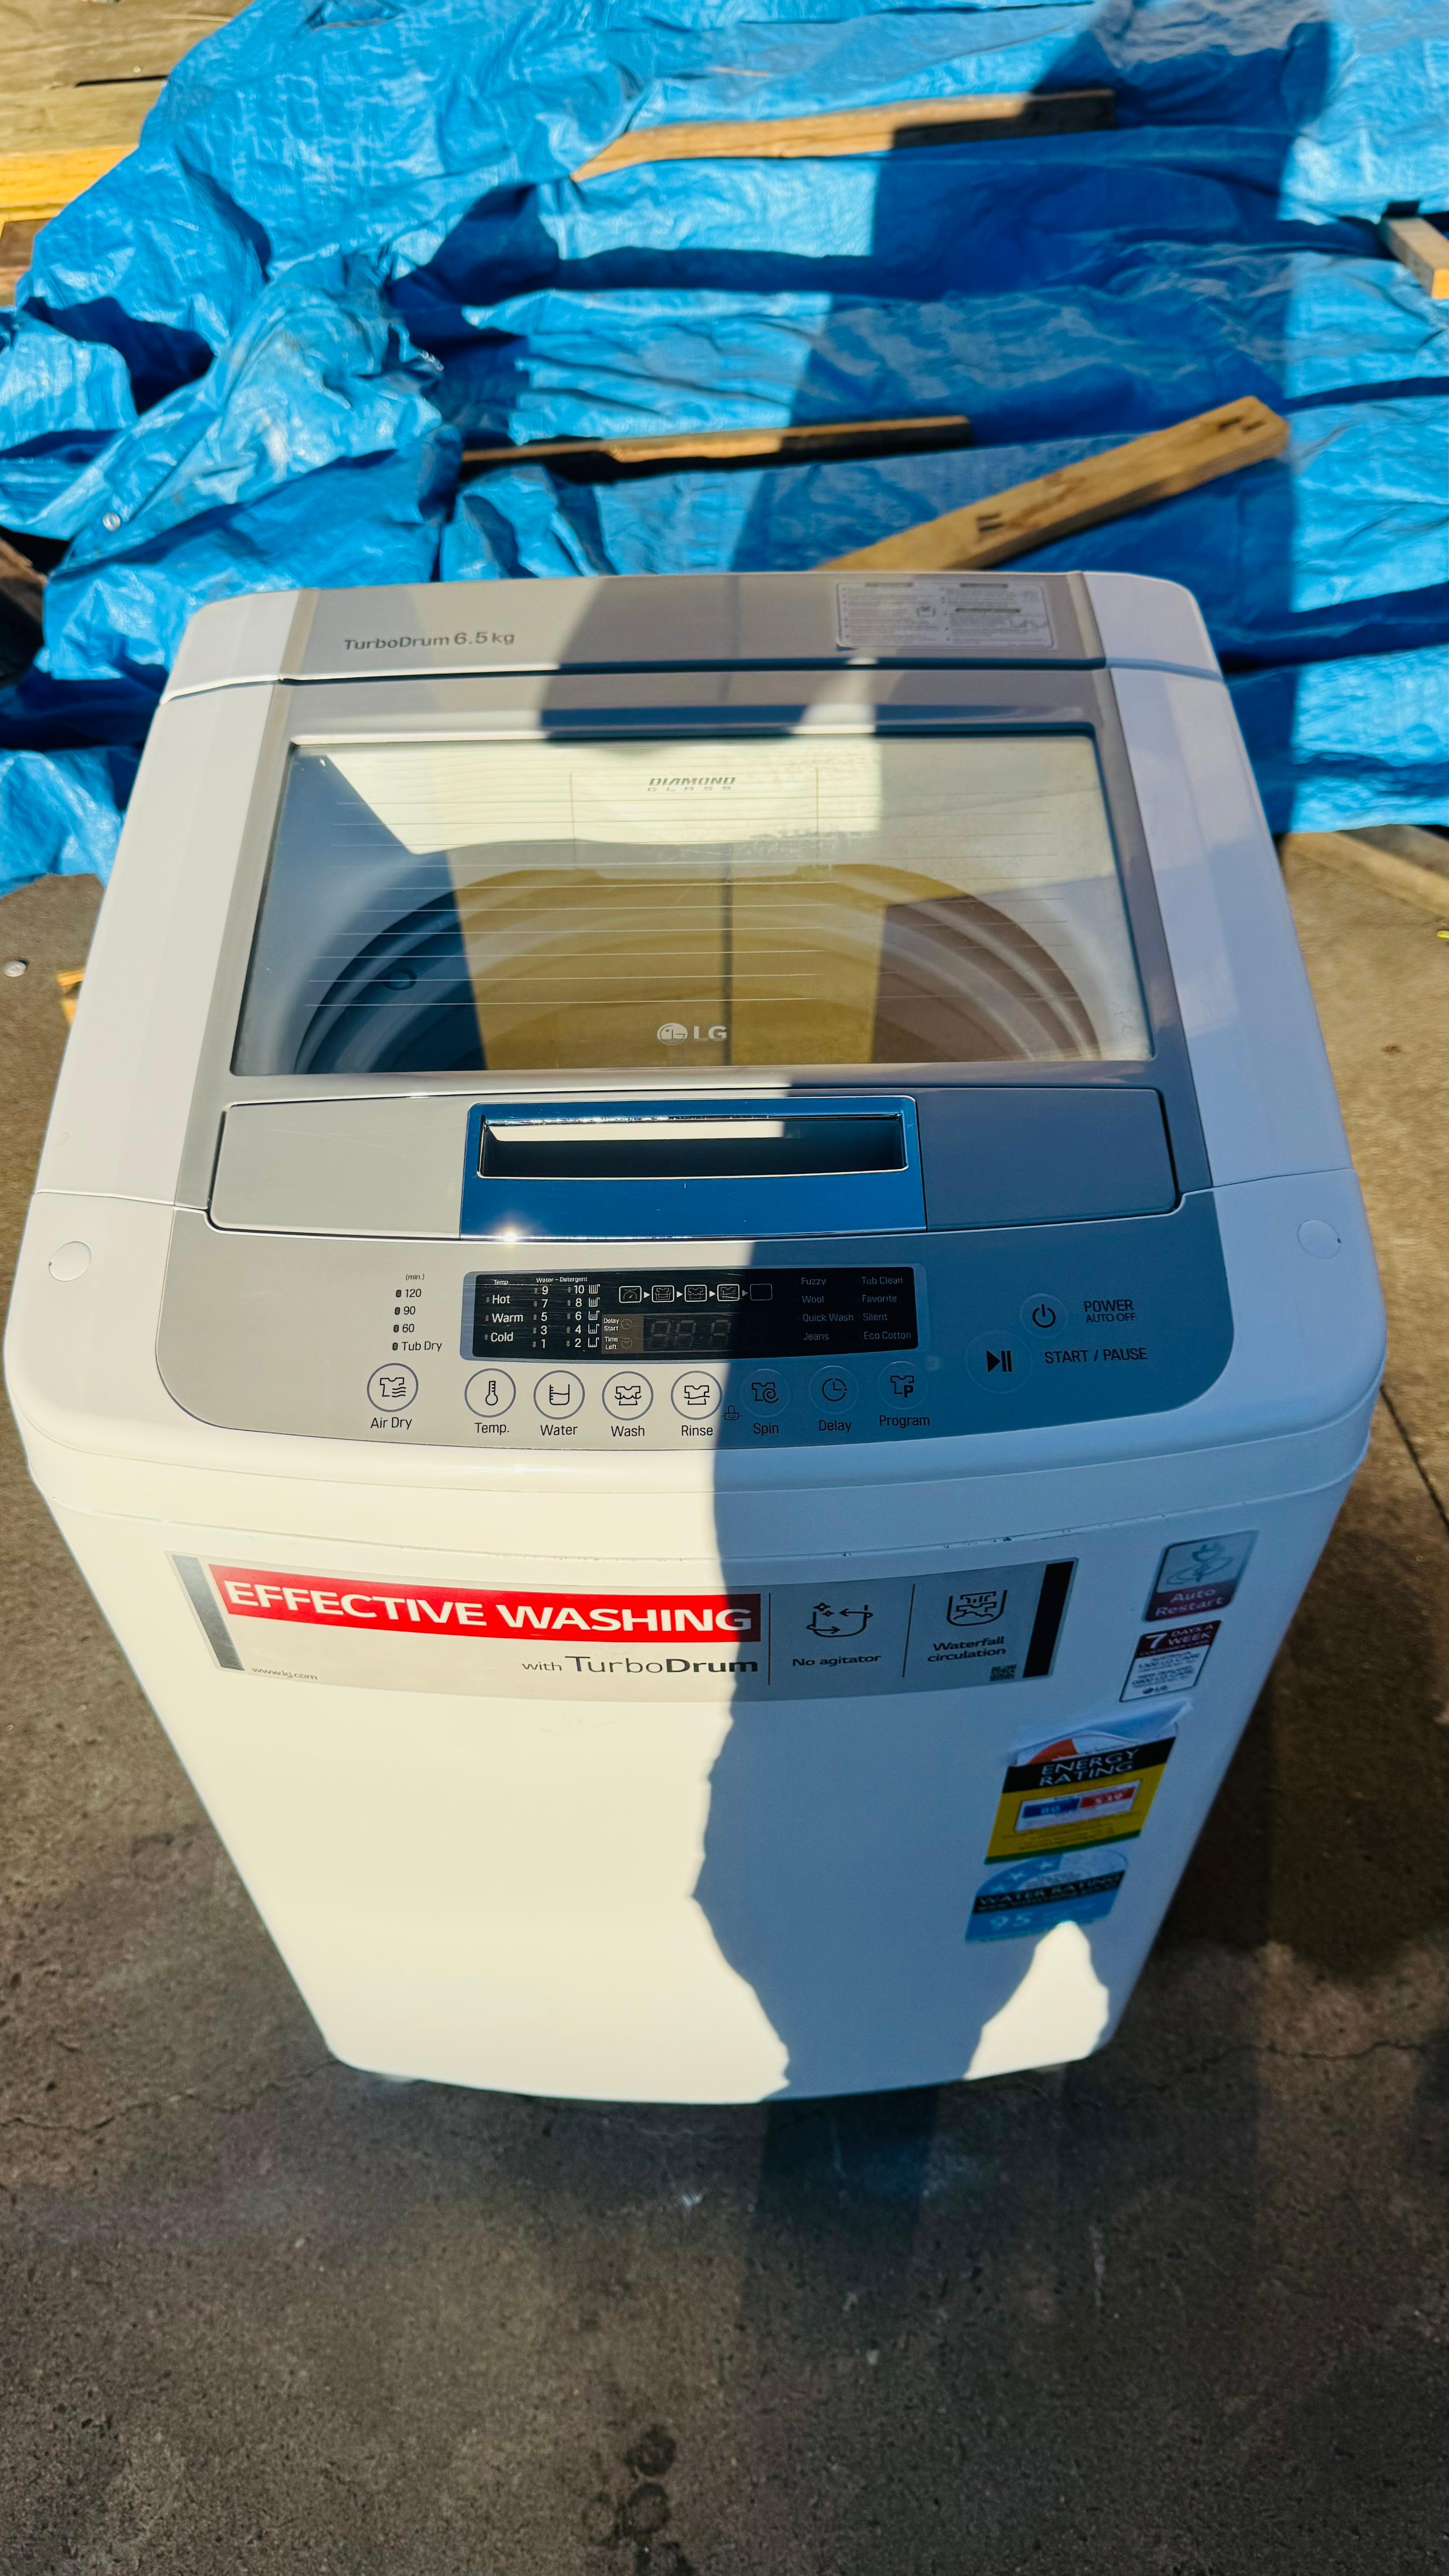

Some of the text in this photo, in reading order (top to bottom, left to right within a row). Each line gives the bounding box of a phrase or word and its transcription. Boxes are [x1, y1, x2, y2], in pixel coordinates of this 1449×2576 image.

[344, 631, 515, 650] TurboDrum 6.5 kg
[649, 777, 736, 786] DIAMOND
[693, 1025, 727, 1041] LG
[801, 1277, 826, 1286] Fuzzy
[861, 1276, 903, 1285] Tub Clean
[404, 1289, 422, 1298] 120
[542, 1286, 548, 1295] 9
[574, 1285, 585, 1294] 10
[492, 1295, 511, 1304] Hot
[541, 1299, 548, 1308] 7
[575, 1298, 582, 1307] 8
[862, 1295, 897, 1303] Favorite
[403, 1306, 416, 1315] 90
[1083, 1299, 1134, 1313] POWER
[492, 1313, 524, 1323] Warm
[541, 1312, 547, 1321] 5
[575, 1312, 582, 1321] 6
[803, 1313, 854, 1322] Quick Wash
[1086, 1313, 1136, 1323] AUTO OFF
[402, 1324, 415, 1333] 60
[540, 1326, 547, 1335] 3
[575, 1325, 582, 1334] 4
[491, 1332, 514, 1342] Cold
[803, 1332, 829, 1341] Jeans
[863, 1331, 911, 1340] Eco Cotton
[402, 1341, 442, 1352] Tub Dry
[541, 1339, 546, 1348] 1
[575, 1338, 581, 1347] 2
[1044, 1349, 1089, 1364] START
[1103, 1347, 1148, 1361] PAUSE
[370, 1417, 413, 1430] Air Dry
[818, 1419, 852, 1433] Delay
[878, 1414, 930, 1429] Program
[474, 1423, 510, 1436] Temp.
[540, 1425, 578, 1436] Water
[611, 1426, 645, 1437] Wash
[681, 1425, 713, 1436] Rinse
[753, 1422, 779, 1435] Spin
[1170, 1589, 1216, 1603] Auto
[223, 1580, 752, 1632] EFFECTIVE WASHING
[1155, 1597, 1225, 1617] Restart
[1171, 1626, 1202, 1637] DAYS
[933, 1636, 1005, 1652] Waterfall
[1146, 1633, 1168, 1649] 7
[1168, 1632, 1211, 1646] WEEK
[927, 1646, 1006, 1662] circulation
[521, 1655, 758, 1674] with TurboDrum
[792, 1654, 882, 1667] No agitator
[252, 1667, 318, 1680] www.lg.com
[1041, 1748, 1141, 1776] ENERGY
[1039, 1761, 1133, 1787] RATING
[980, 1889, 1046, 1905] WATER
